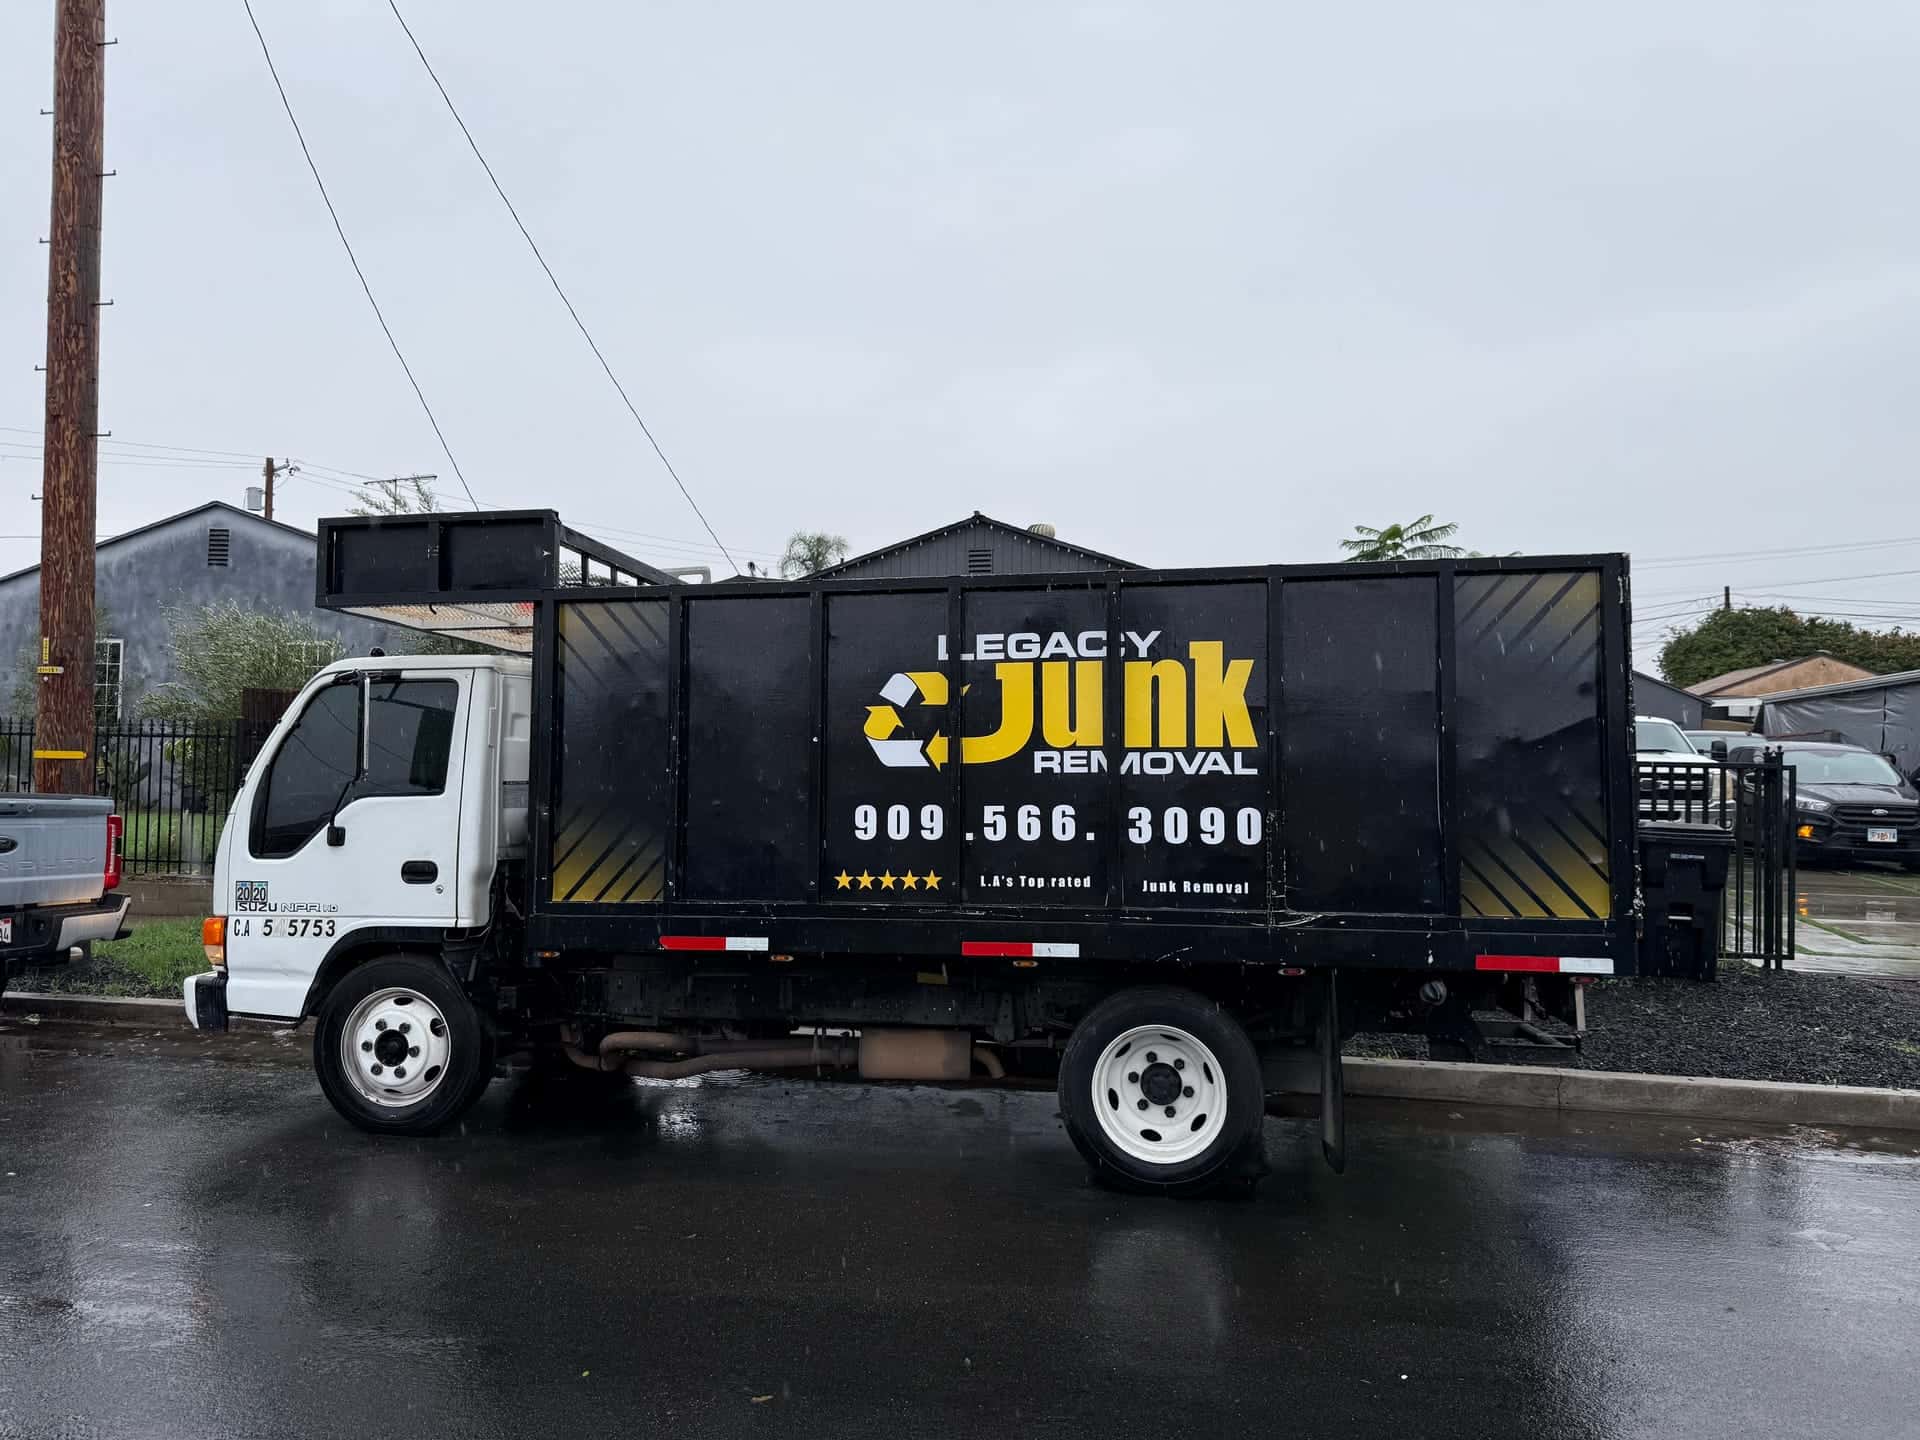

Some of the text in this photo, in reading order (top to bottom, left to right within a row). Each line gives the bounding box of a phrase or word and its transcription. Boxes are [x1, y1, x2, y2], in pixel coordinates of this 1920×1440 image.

[938, 631, 1161, 660] LEGACY
[961, 641, 1258, 764] Junk
[1033, 751, 1258, 775] REMOVAL
[854, 804, 944, 841] 909
[1127, 806, 1263, 845] 3090
[237, 887, 267, 901] 20 20
[980, 875, 1249, 895] L.A's Top rated Junk Removal
[235, 902, 278, 912] ISUZU
[280, 902, 321, 912] NPR
